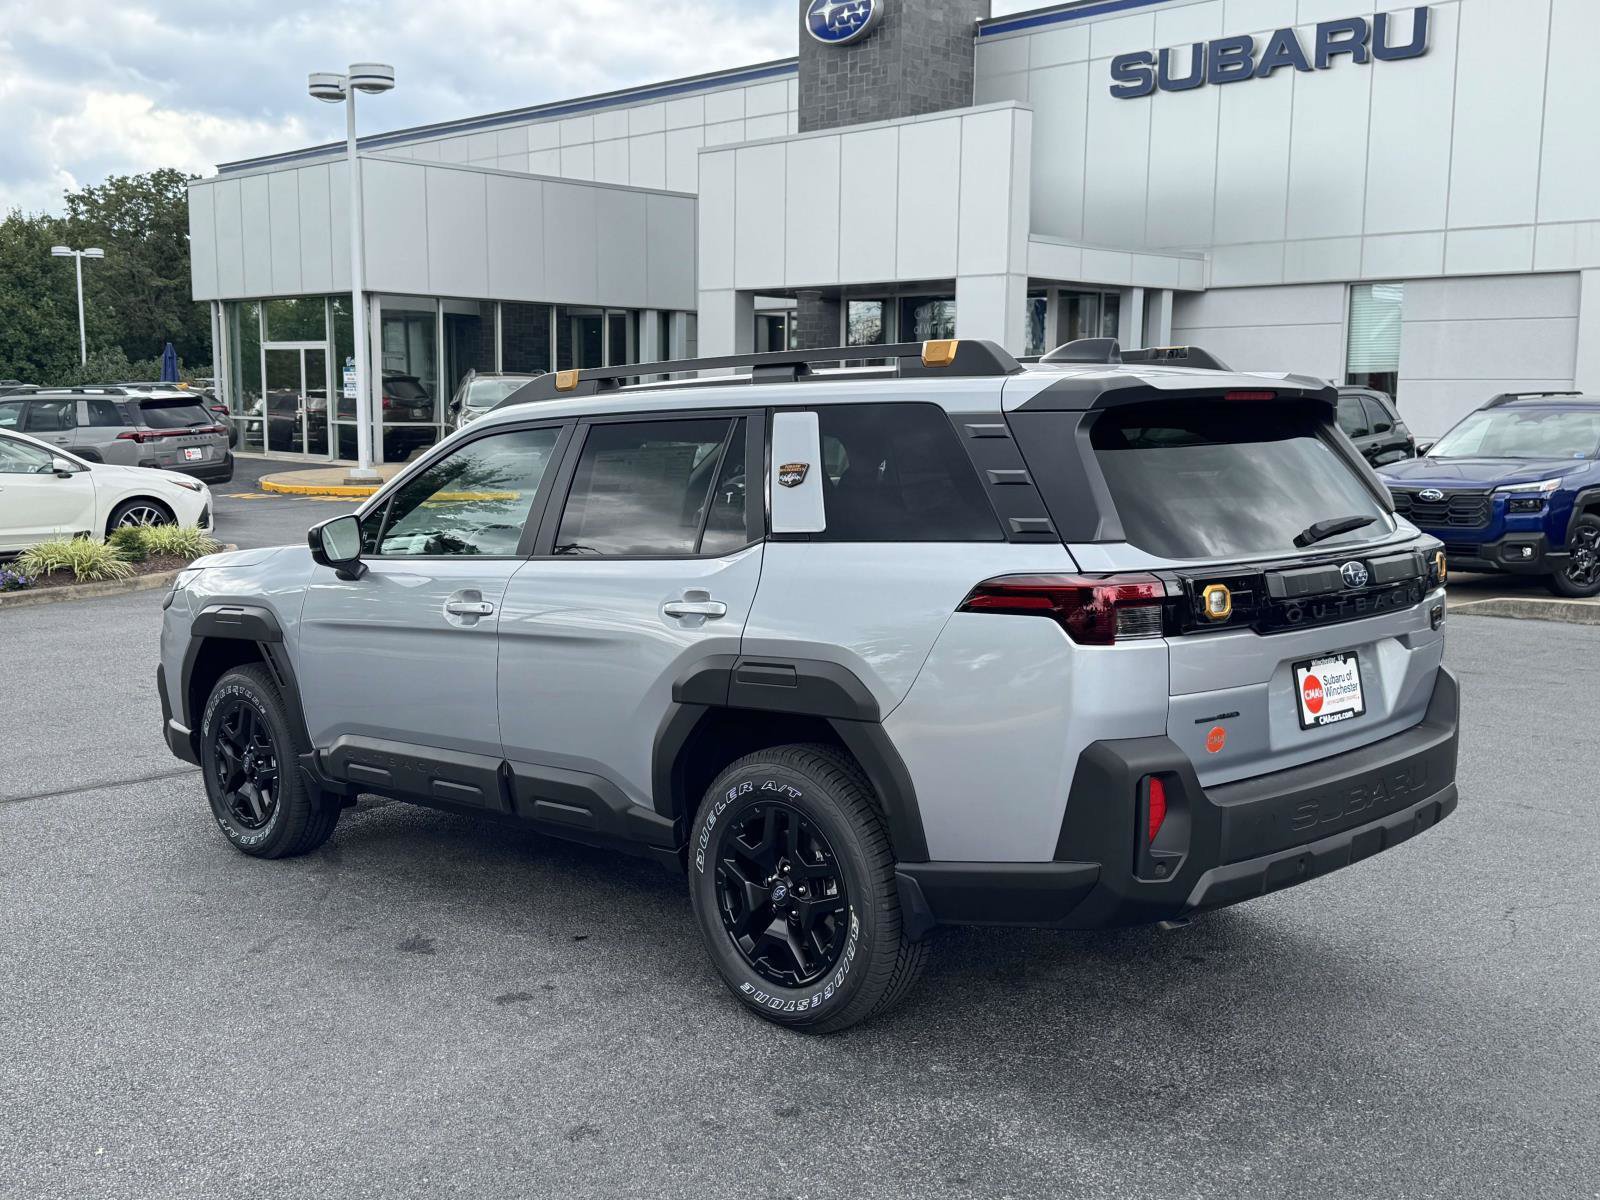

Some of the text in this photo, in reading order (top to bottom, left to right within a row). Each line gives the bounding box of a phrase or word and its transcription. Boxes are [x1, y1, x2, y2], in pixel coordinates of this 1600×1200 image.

[1109, 6, 1430, 99] SUBARU
[1286, 587, 1420, 622] OUTBACK
[1323, 670, 1353, 686] Subaru of
[1325, 682, 1358, 698] Winchester
[1319, 710, 1354, 725] CMAcars.com
[1291, 760, 1429, 831] SUBARU
[696, 780, 803, 873] DUELER A/T
[740, 905, 860, 1012] BRIDGESTONE
